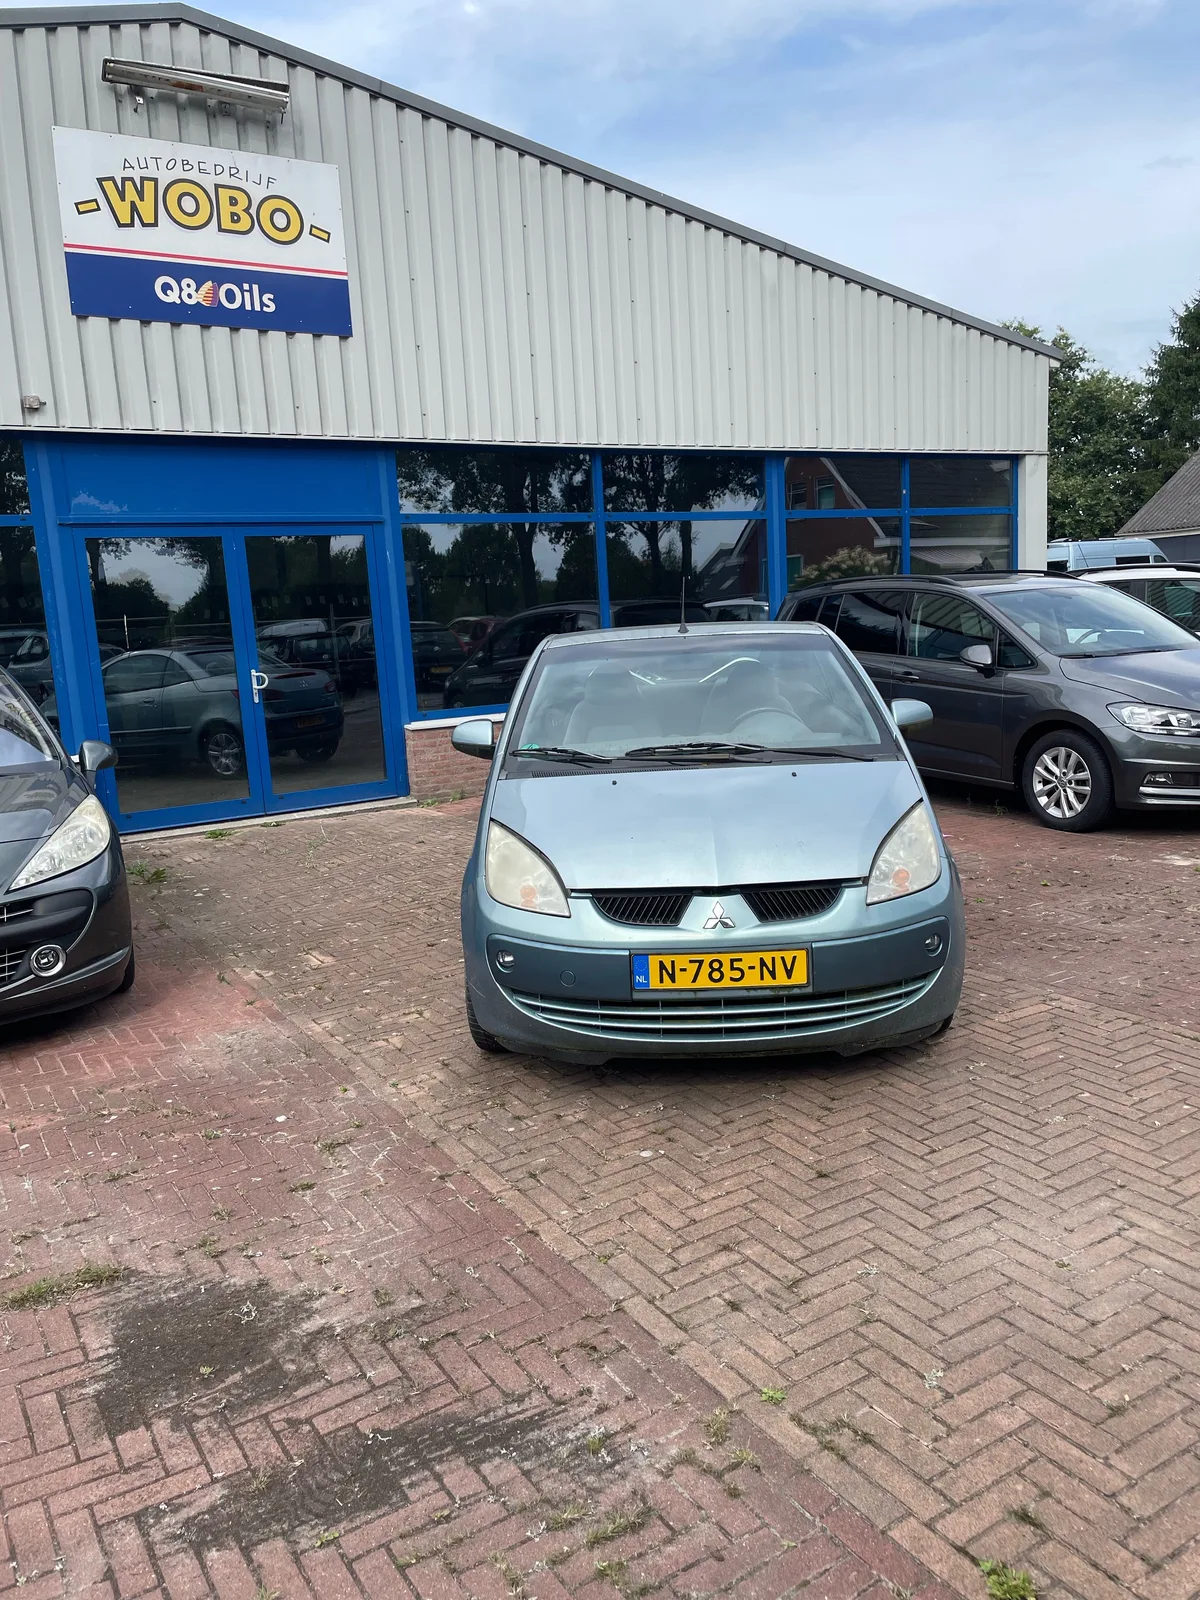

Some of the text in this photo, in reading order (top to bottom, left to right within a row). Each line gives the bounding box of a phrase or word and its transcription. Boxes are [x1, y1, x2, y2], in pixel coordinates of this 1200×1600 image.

[122, 156, 277, 189] AUTOBEDRIJF
[219, 283, 276, 312] Oils
[635, 955, 798, 984] NL N-785-NV
